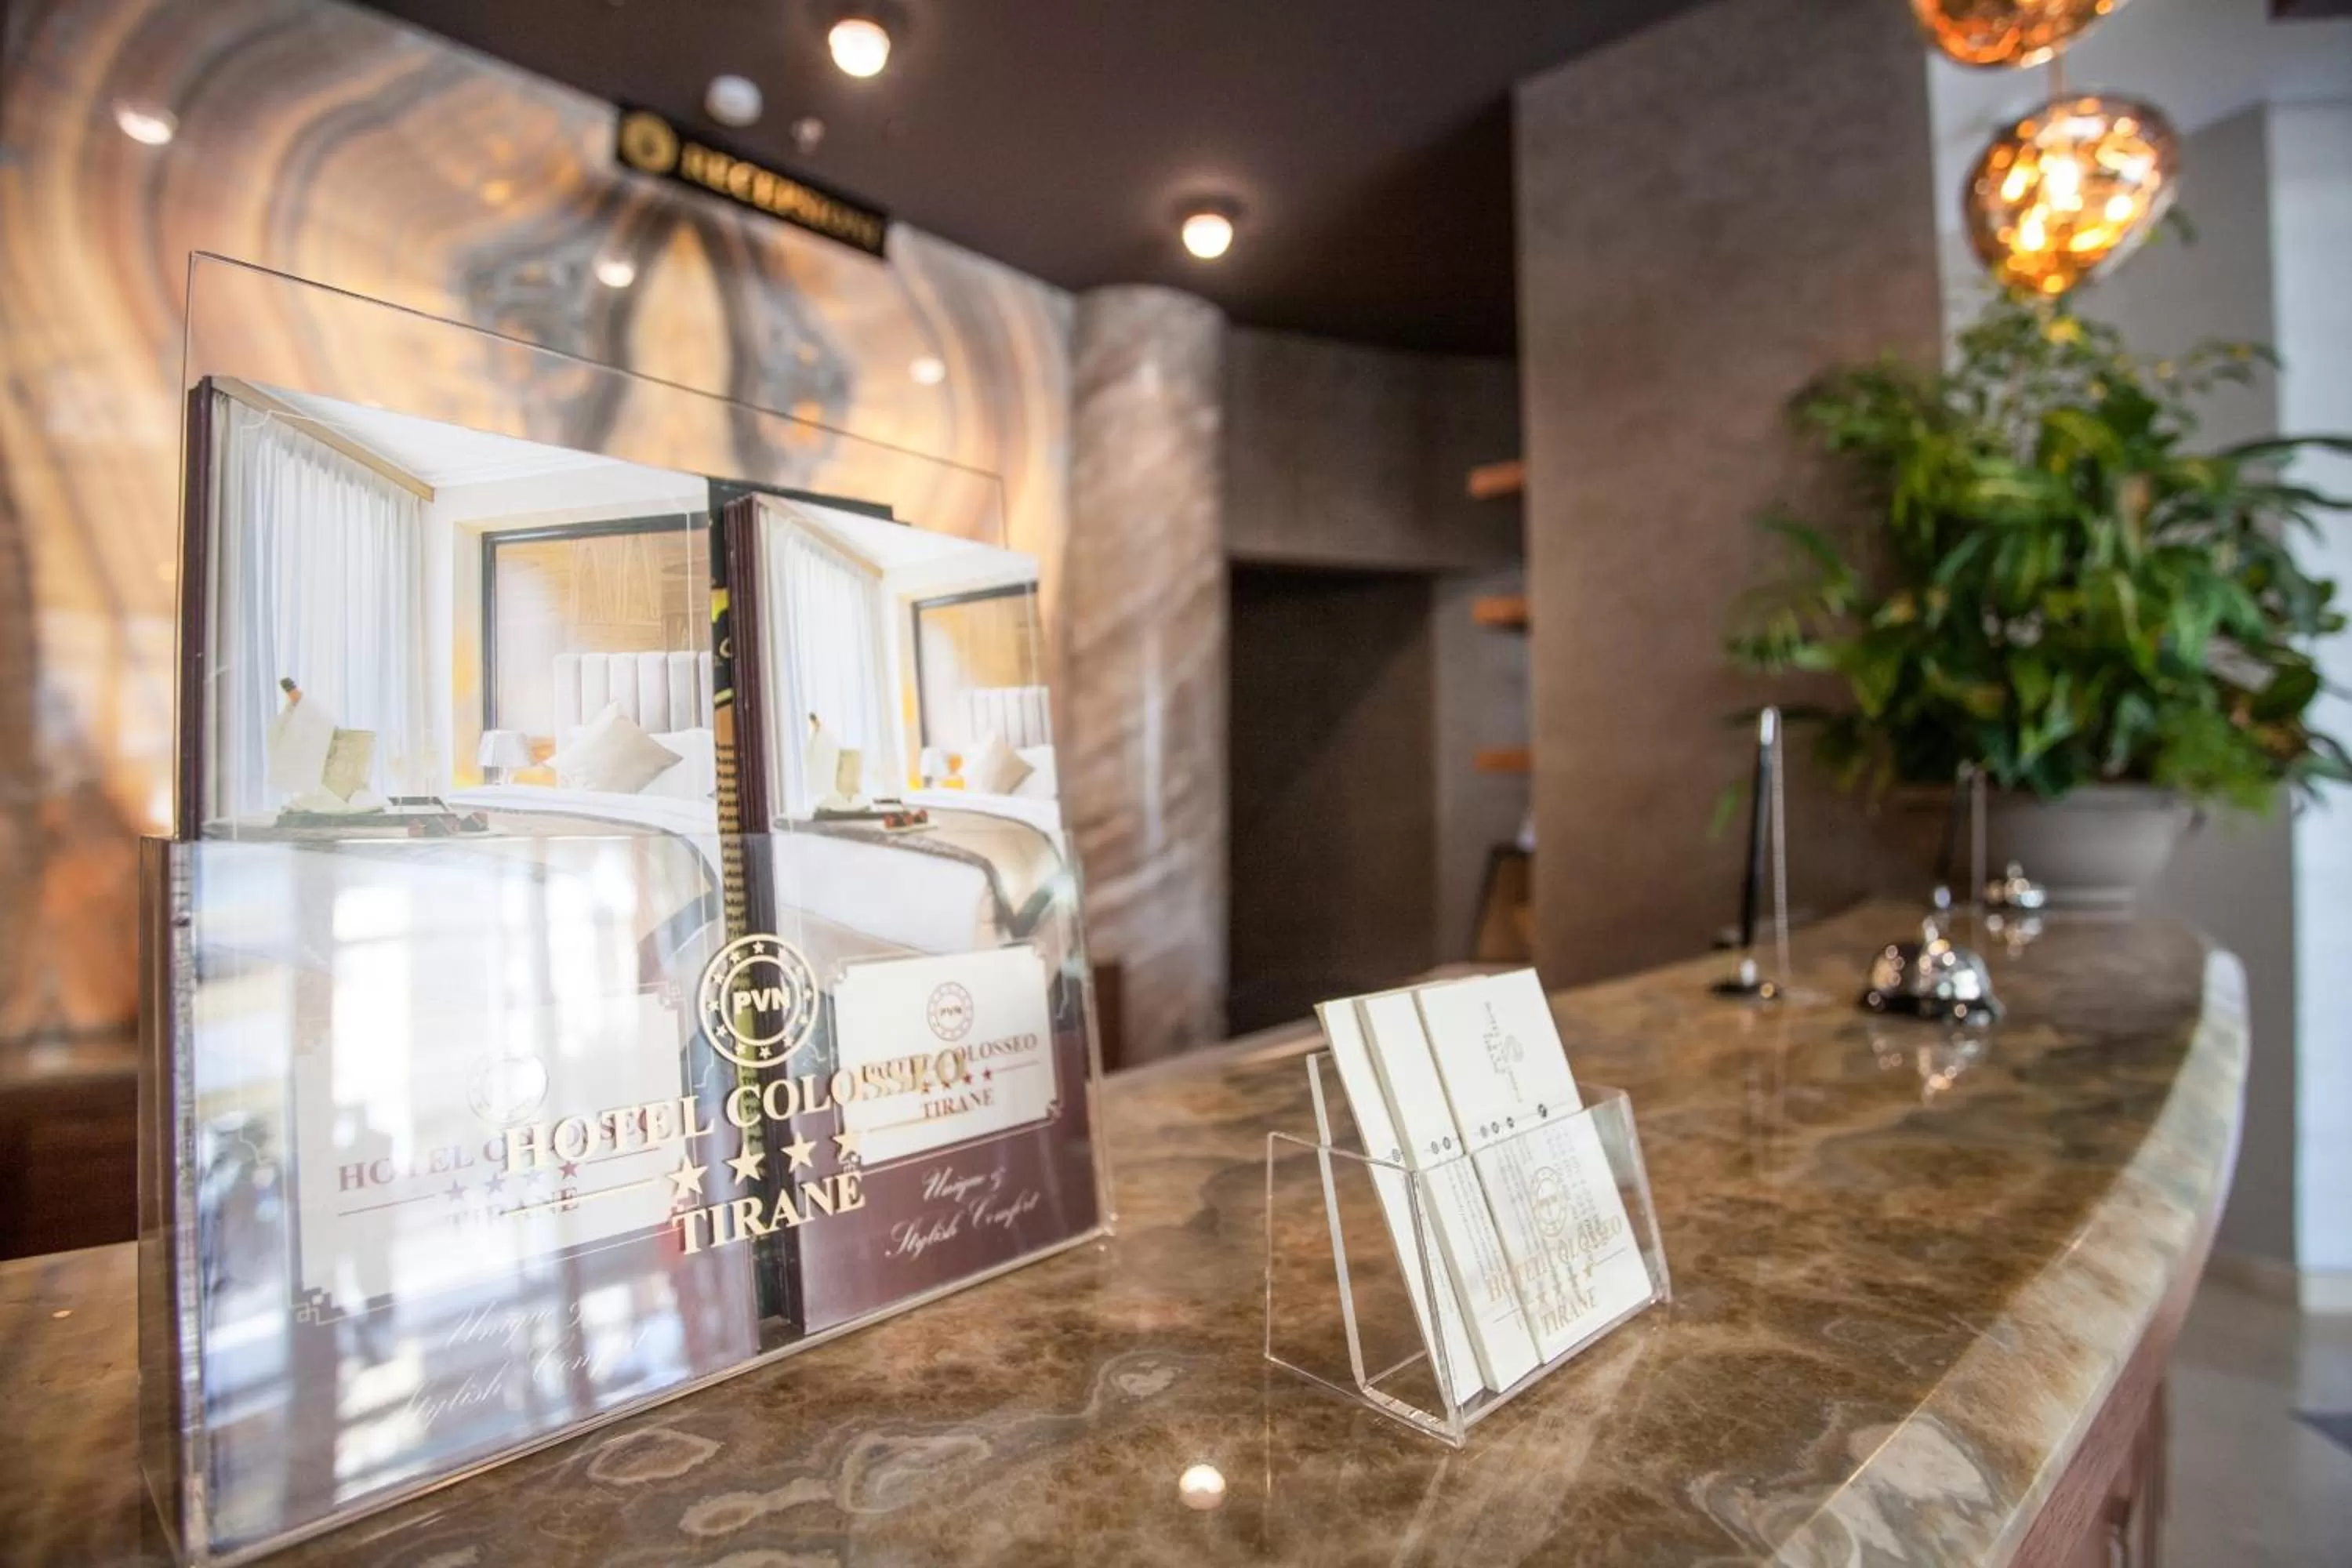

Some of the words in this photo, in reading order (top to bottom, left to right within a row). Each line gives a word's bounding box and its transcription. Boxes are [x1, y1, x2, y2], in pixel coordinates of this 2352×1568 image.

[733, 987, 791, 1014] PVN
[506, 1094, 713, 1174] HOTEL
[726, 1047, 967, 1128] COLOSSEO
[920, 1088, 996, 1119] TIRANE
[338, 1143, 475, 1192] HOEL
[673, 1171, 865, 1255] TIRANE
